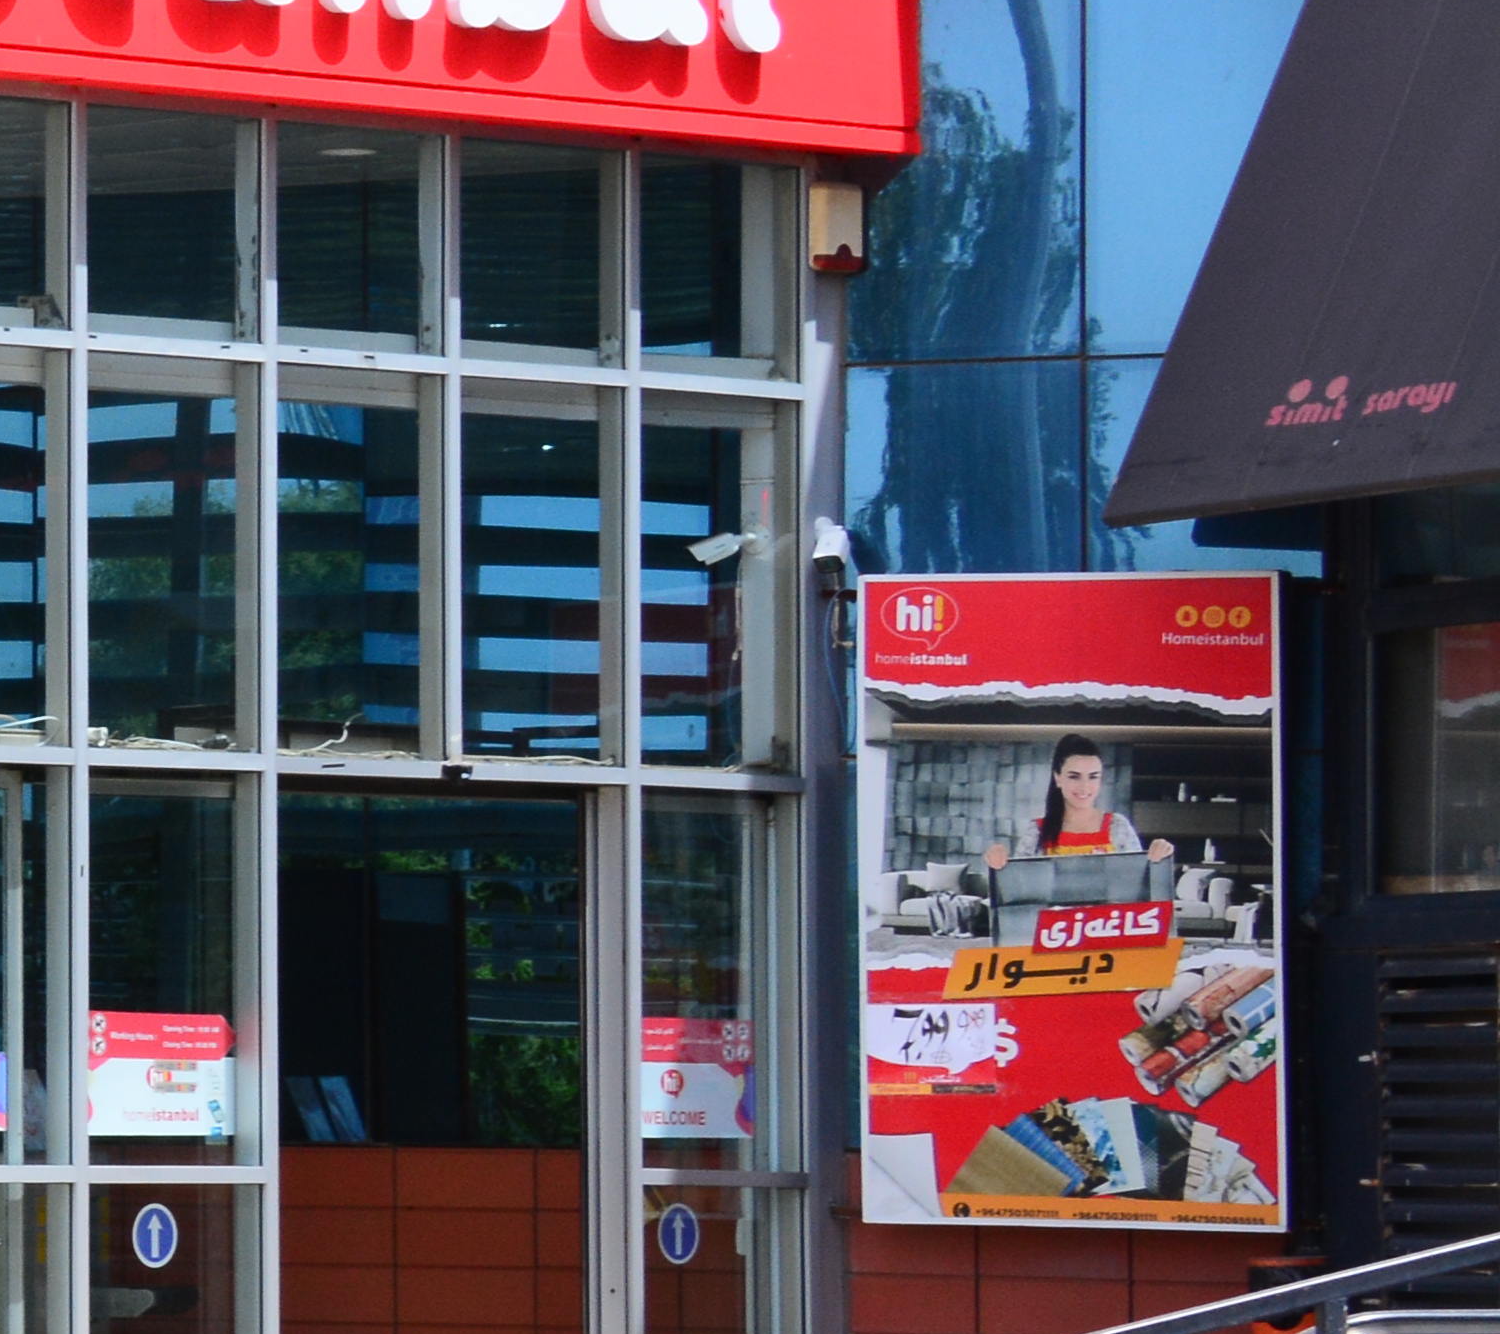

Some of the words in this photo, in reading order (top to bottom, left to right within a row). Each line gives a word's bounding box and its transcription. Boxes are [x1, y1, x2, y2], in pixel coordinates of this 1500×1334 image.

[1265, 375, 1349, 426] simit
[896, 594, 944, 632] hi!
[1161, 632, 1263, 646] Homeistanbul
[875, 653, 967, 665] homeistanbul
[123, 1108, 199, 1122] homeistanbul
[642, 1111, 706, 1125] WELCOME
